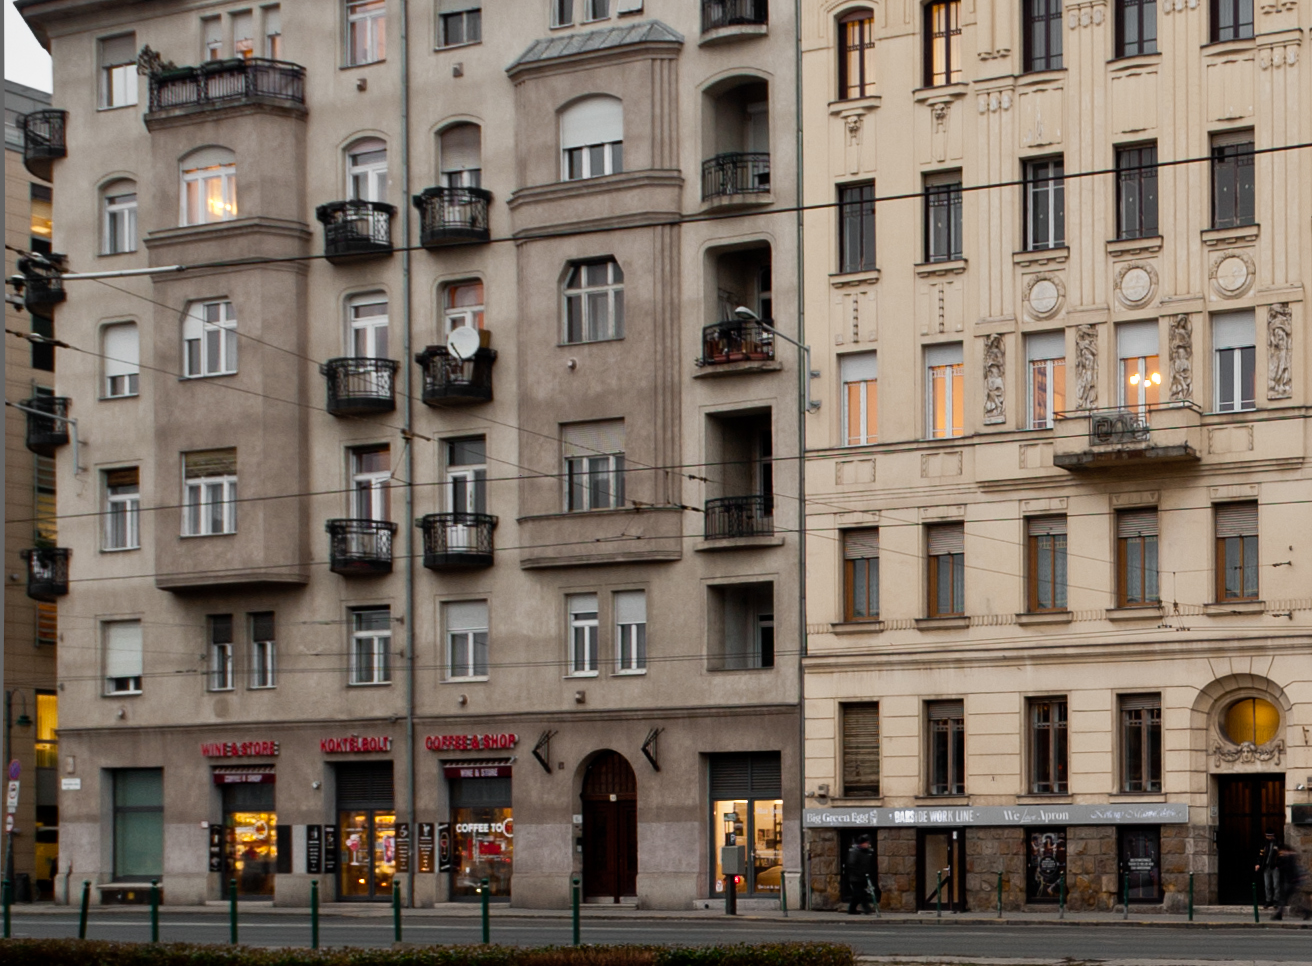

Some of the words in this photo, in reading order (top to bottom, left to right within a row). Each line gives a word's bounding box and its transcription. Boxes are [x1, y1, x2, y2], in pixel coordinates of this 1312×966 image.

[200, 742, 231, 756] WINE
[231, 741, 240, 755] &
[241, 740, 279, 755] STORE
[425, 735, 469, 750] COFFEE
[471, 734, 480, 749] &
[483, 733, 517, 749] SHOP
[806, 813, 821, 824] Big
[822, 812, 850, 823] Green
[851, 812, 869, 824] Egg
[929, 810, 953, 822] WORK
[956, 810, 974, 822] LINE
[1003, 809, 1020, 821] We
[1037, 809, 1069, 823] Apron
[455, 822, 489, 833] COFFEE
[490, 822, 503, 833] TO
